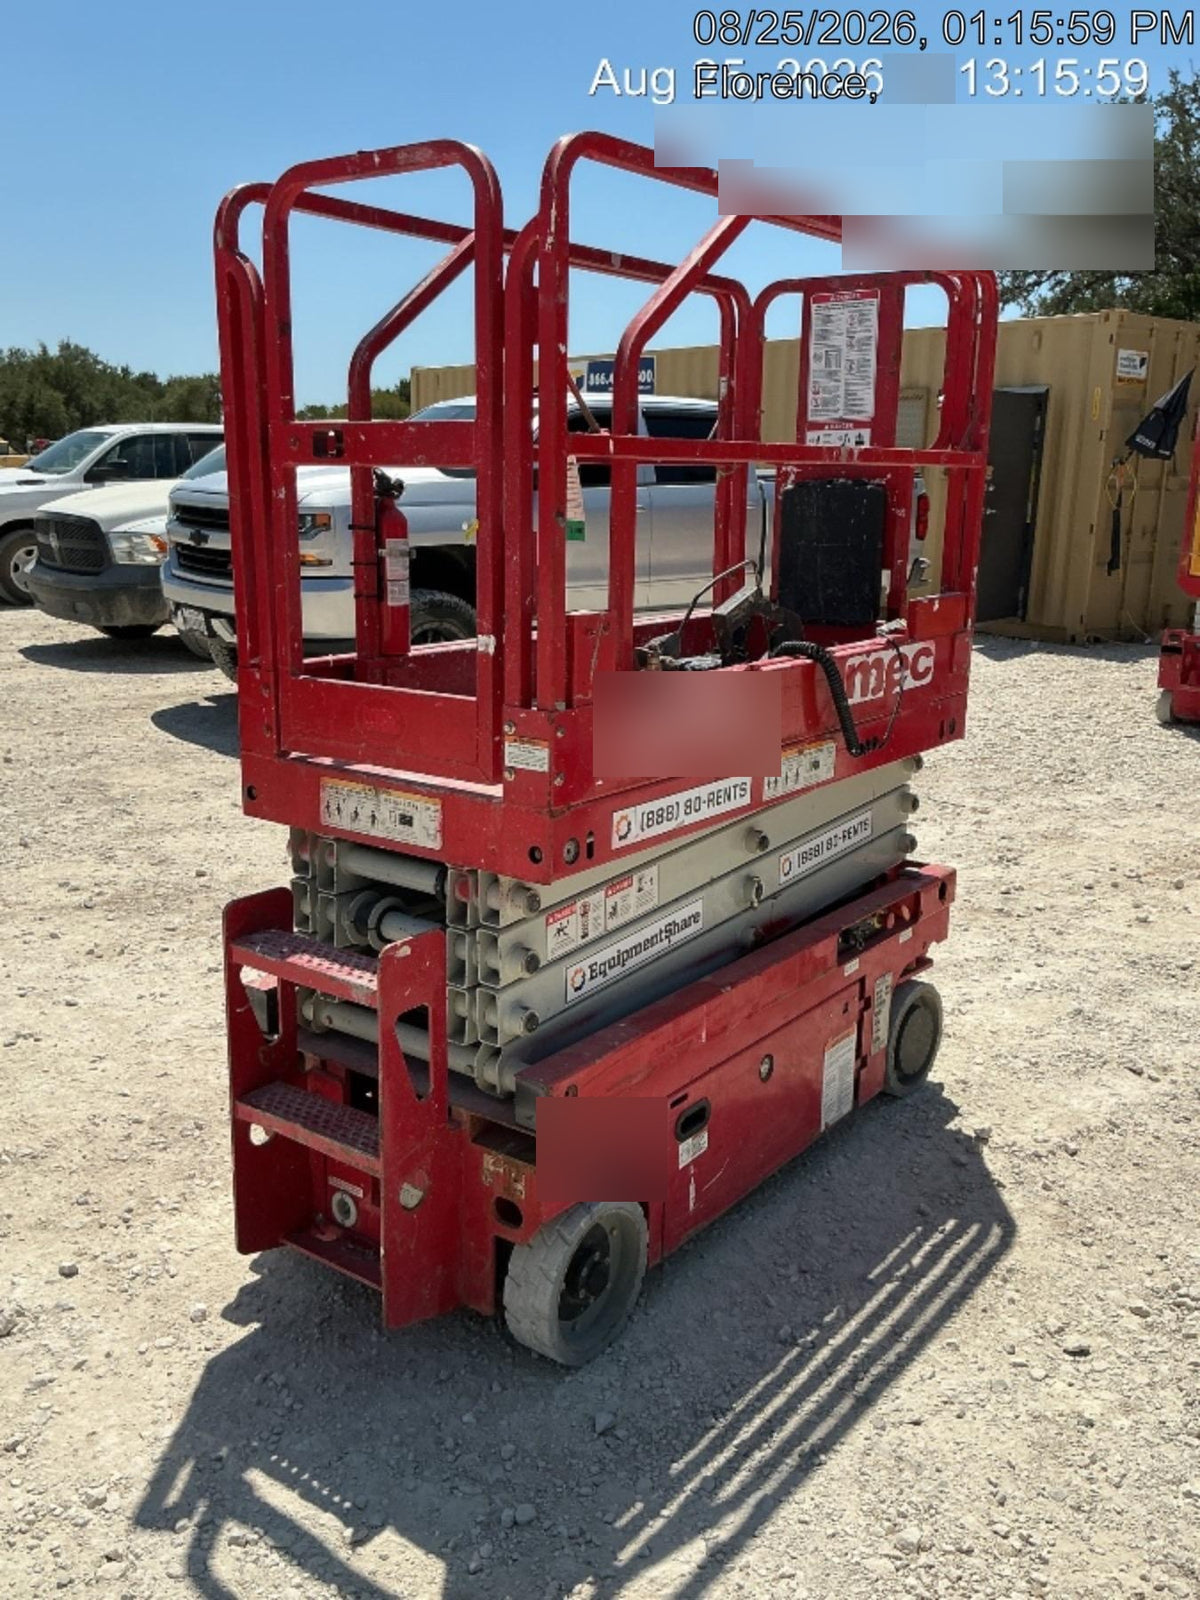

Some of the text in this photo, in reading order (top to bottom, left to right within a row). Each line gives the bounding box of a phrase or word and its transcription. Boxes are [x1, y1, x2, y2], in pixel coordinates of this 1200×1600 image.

[845, 646, 934, 699] mec
[684, 781, 748, 816] 80-RENTS
[588, 911, 701, 980] EquipmentShare
